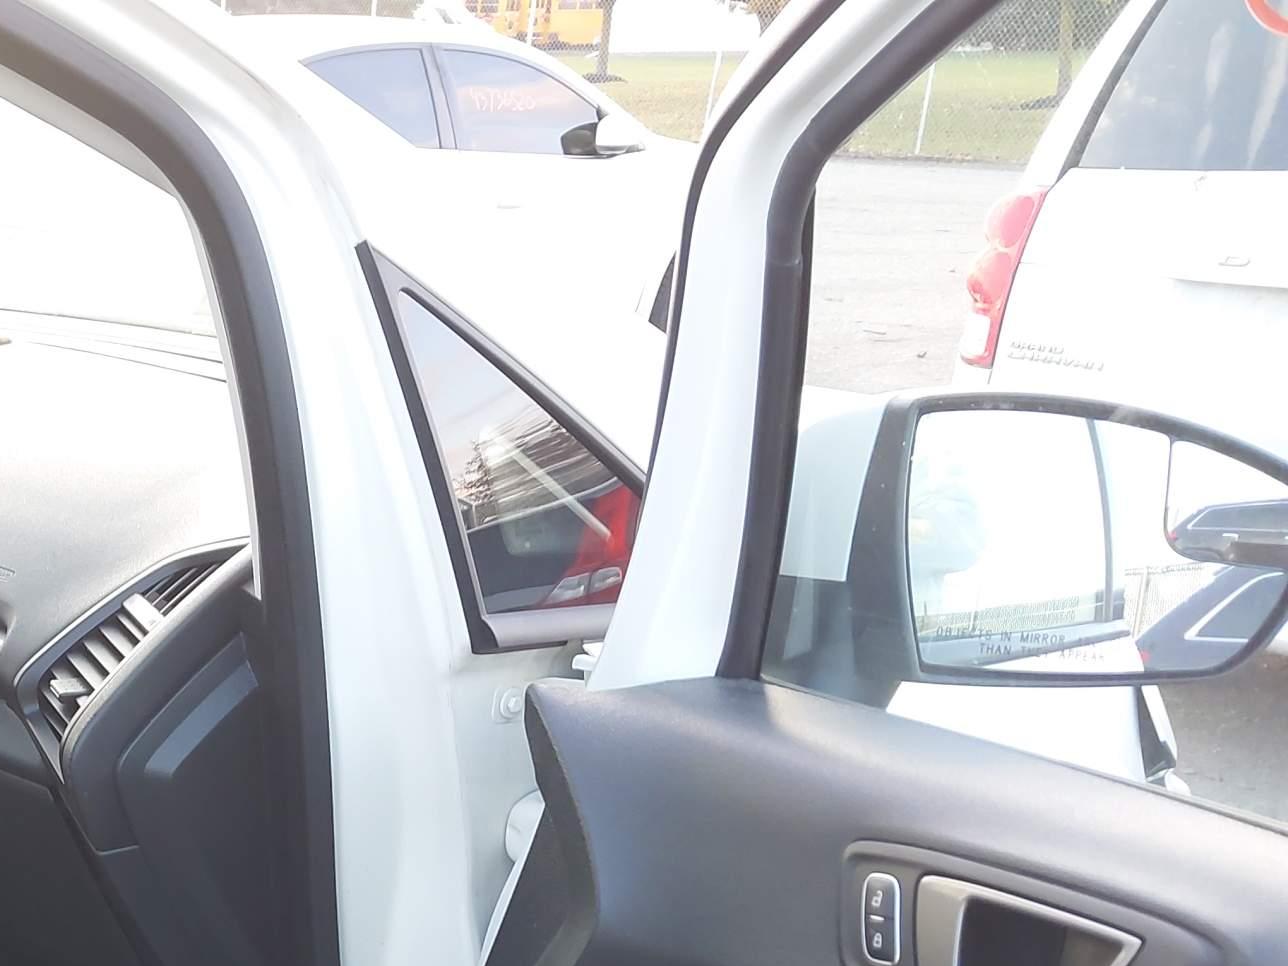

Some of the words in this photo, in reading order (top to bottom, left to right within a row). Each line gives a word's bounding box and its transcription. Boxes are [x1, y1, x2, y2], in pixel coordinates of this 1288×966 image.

[1000, 632, 1013, 641] IN
[1019, 632, 1066, 644] MIRROR
[979, 643, 1011, 655] THAN
